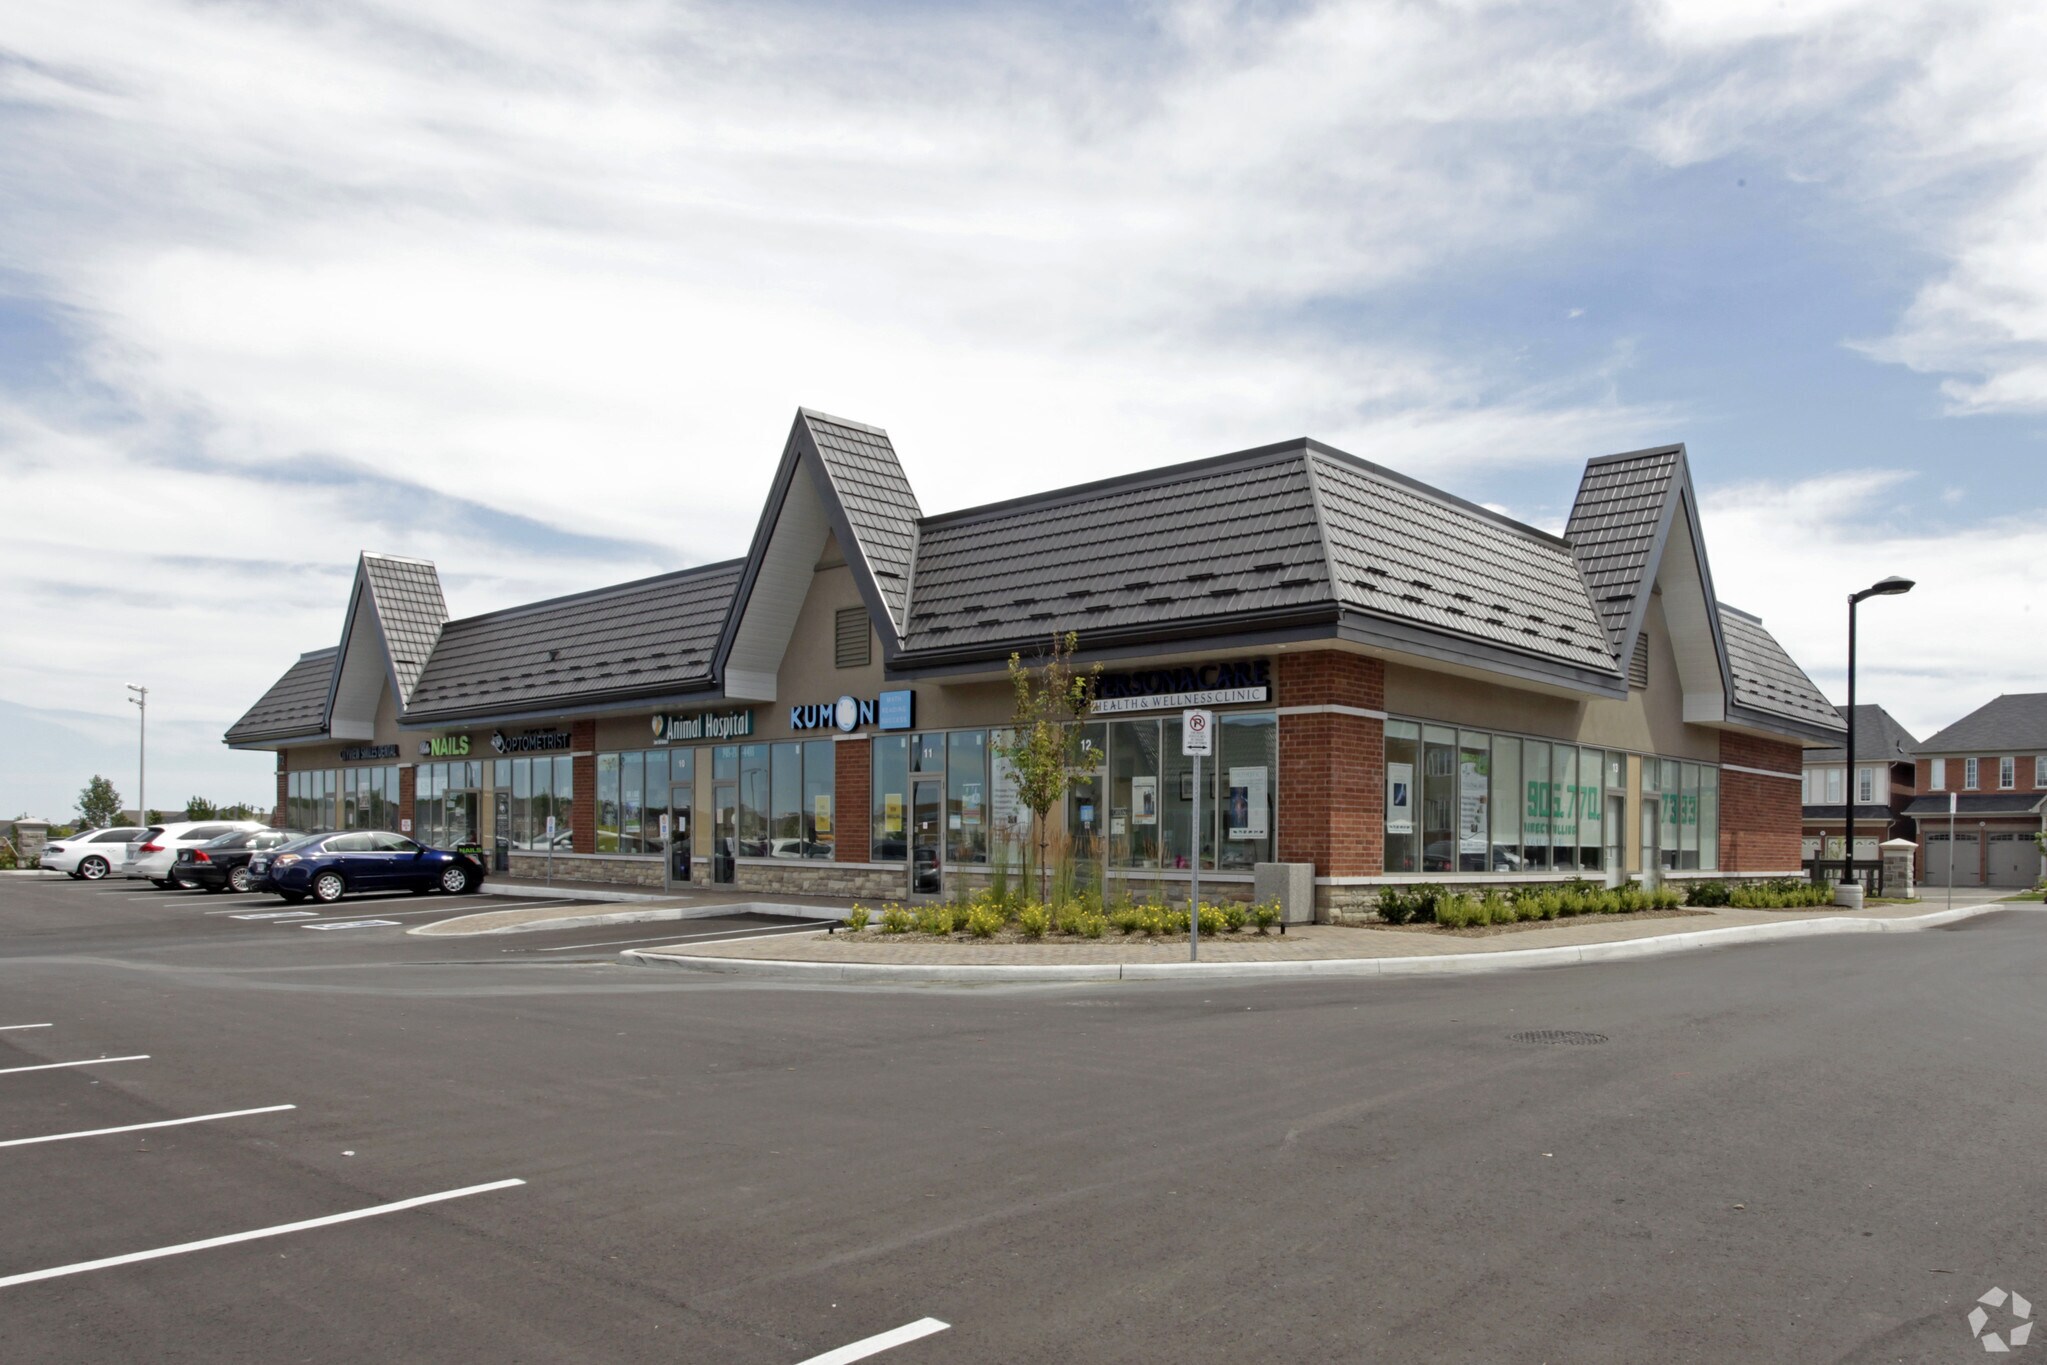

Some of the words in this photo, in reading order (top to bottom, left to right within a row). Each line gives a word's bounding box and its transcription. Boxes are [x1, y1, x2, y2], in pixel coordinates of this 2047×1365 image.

[1092, 699, 1138, 712] HEALTH
[1140, 698, 1149, 708] &
[1151, 692, 1213, 707] WELLNESS
[1215, 689, 1261, 702] CLINIC
[790, 695, 874, 732] KUMON
[667, 715, 701, 740] Animal
[705, 710, 749, 740] Hospital
[431, 736, 469, 756] NAILS
[505, 732, 568, 752] OPTOMETRIST
[1080, 739, 1092, 751] 12
[923, 748, 933, 758] 11
